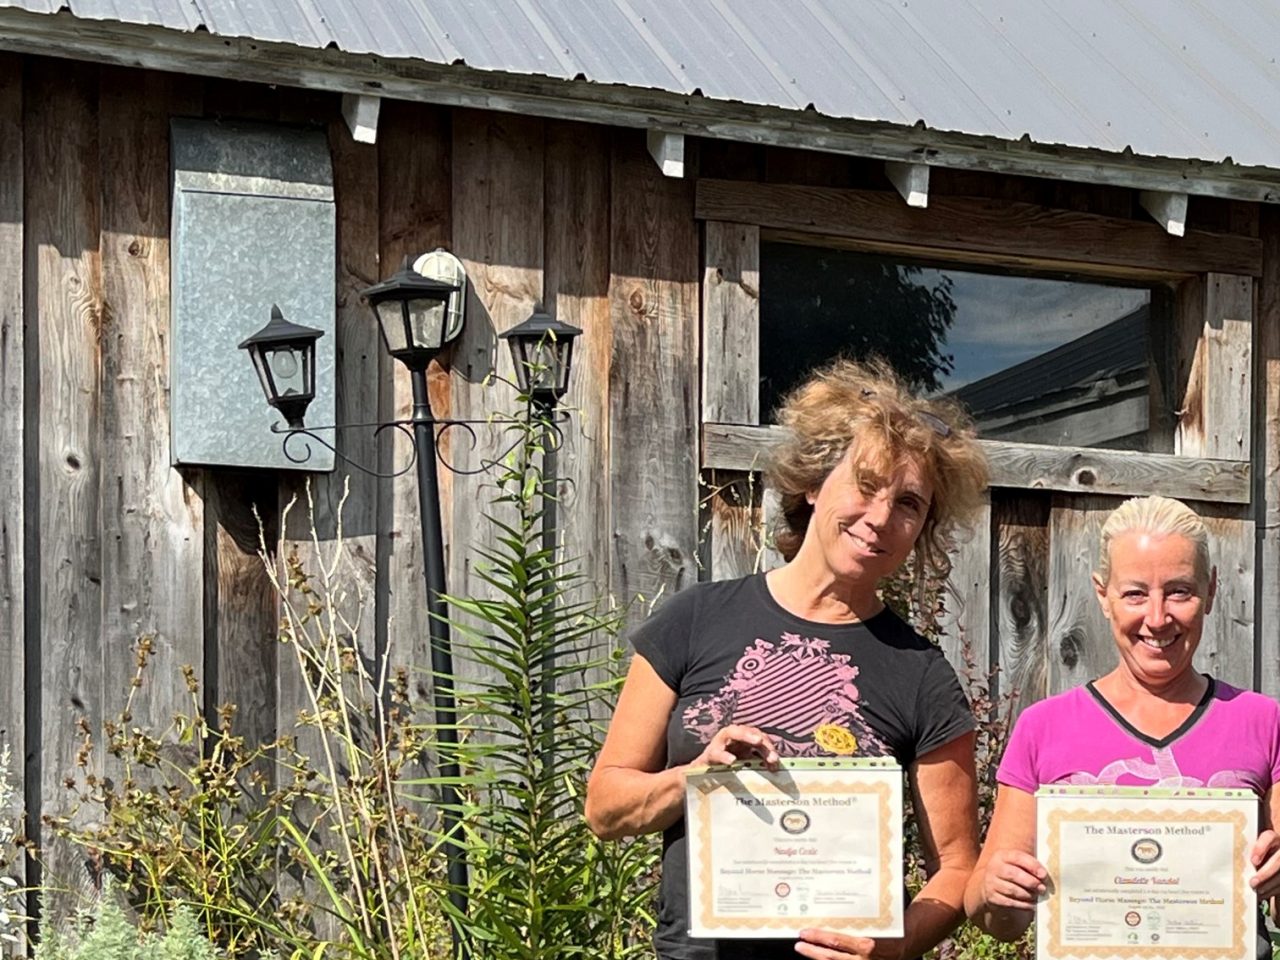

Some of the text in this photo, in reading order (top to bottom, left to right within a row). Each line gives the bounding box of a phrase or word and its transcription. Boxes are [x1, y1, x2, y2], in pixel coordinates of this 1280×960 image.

[735, 797, 753, 806] The
[755, 798, 810, 806] Masterson
[1084, 826, 1104, 835] The
[1106, 826, 1162, 835] Masterson
